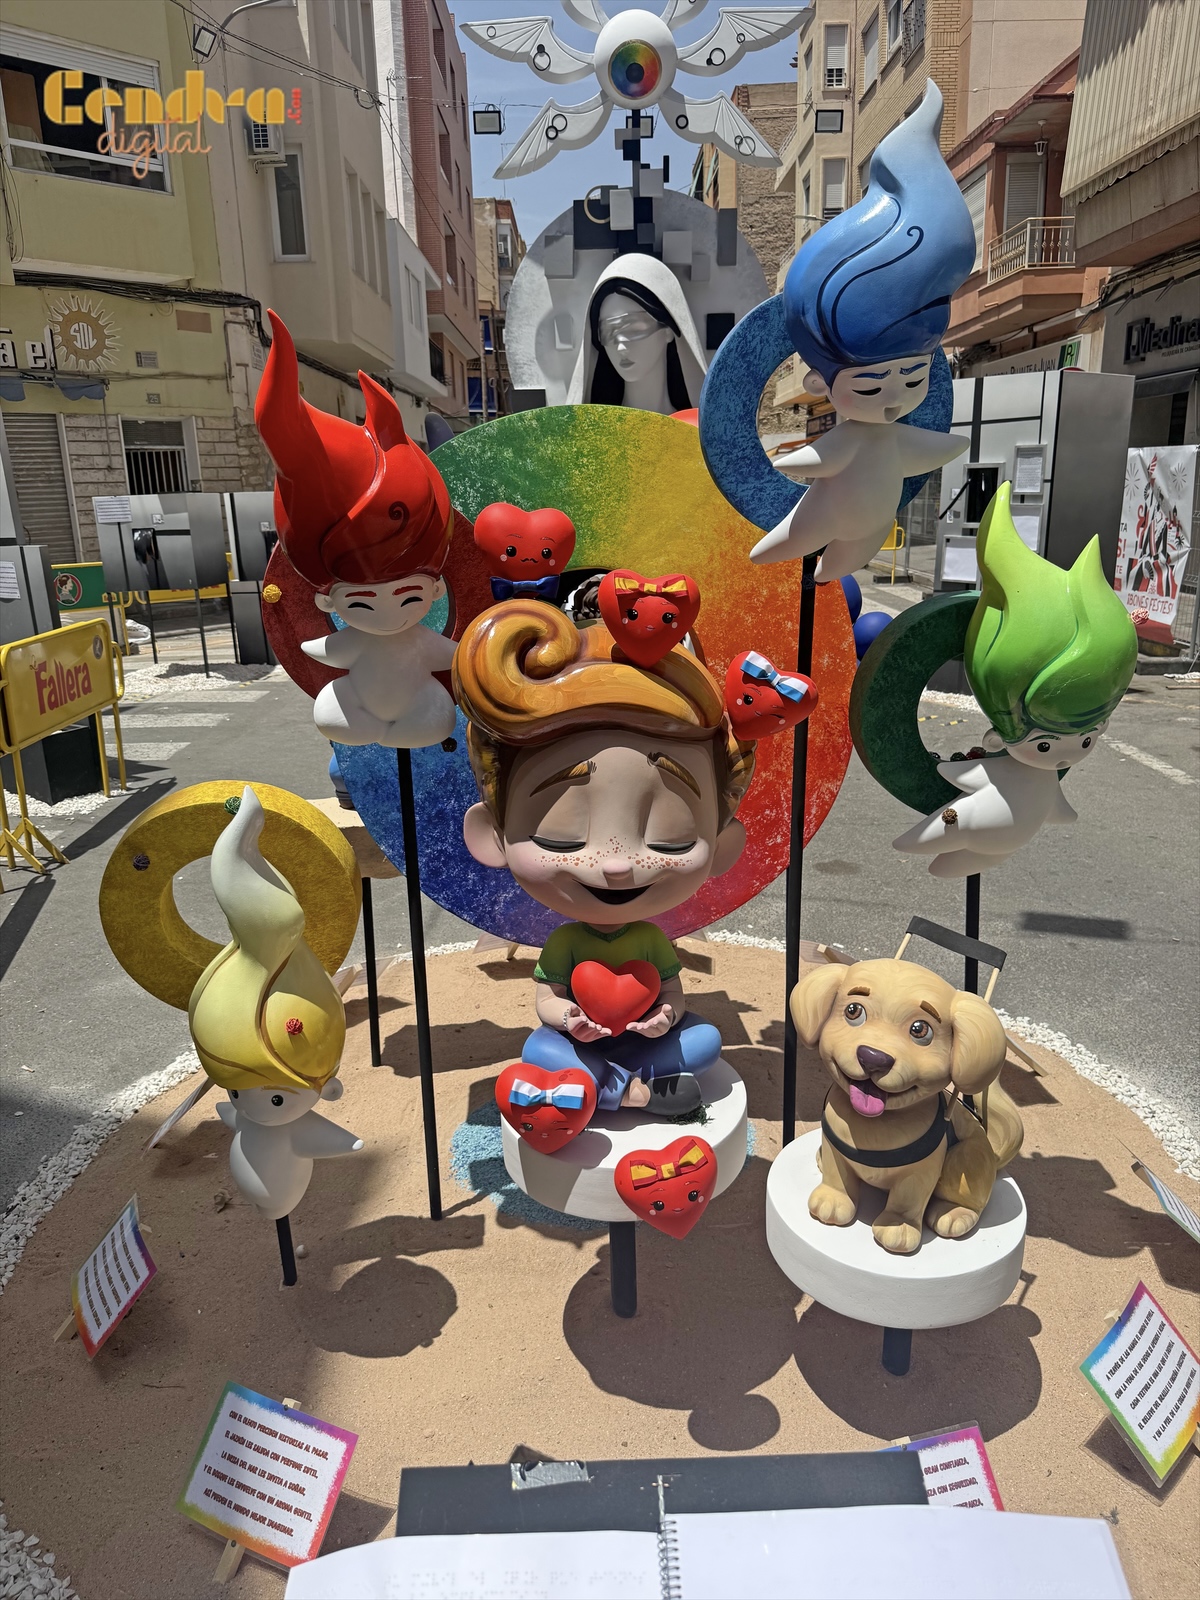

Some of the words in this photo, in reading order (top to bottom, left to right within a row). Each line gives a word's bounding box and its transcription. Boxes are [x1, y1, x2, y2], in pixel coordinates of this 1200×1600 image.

[70, 322, 98, 350] SOL
[34, 659, 92, 716] Fallera
[924, 1465, 939, 1475] GRAN
[937, 1485, 948, 1495] CON
